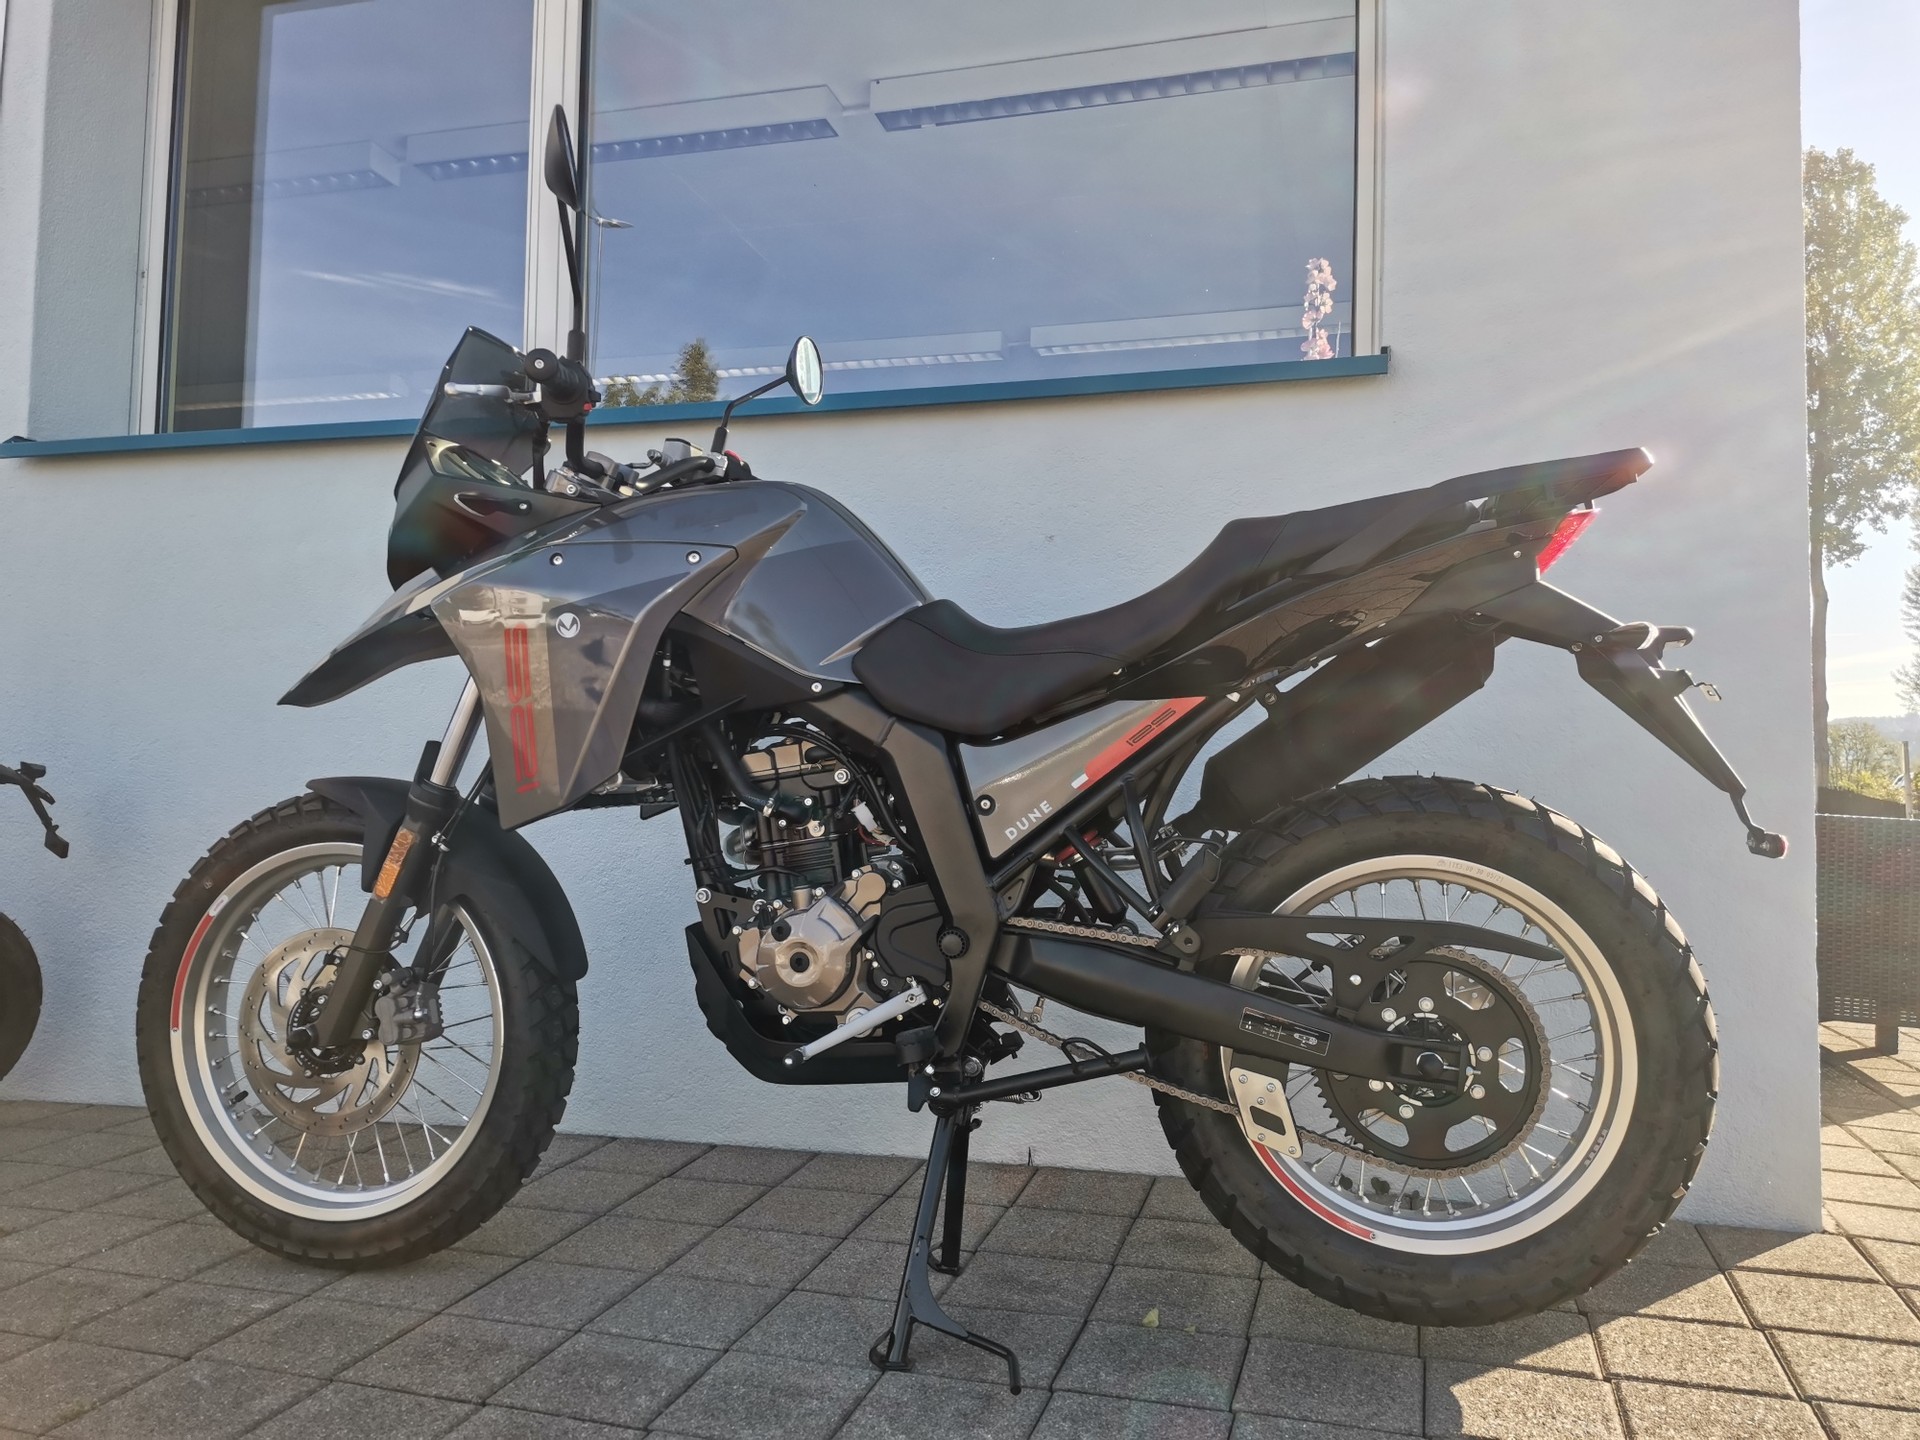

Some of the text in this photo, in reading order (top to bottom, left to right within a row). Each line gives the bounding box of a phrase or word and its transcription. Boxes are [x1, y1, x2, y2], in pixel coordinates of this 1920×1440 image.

[504, 622, 541, 794] 125
[1126, 707, 1177, 747] 125
[1004, 800, 1053, 841] DUNE
